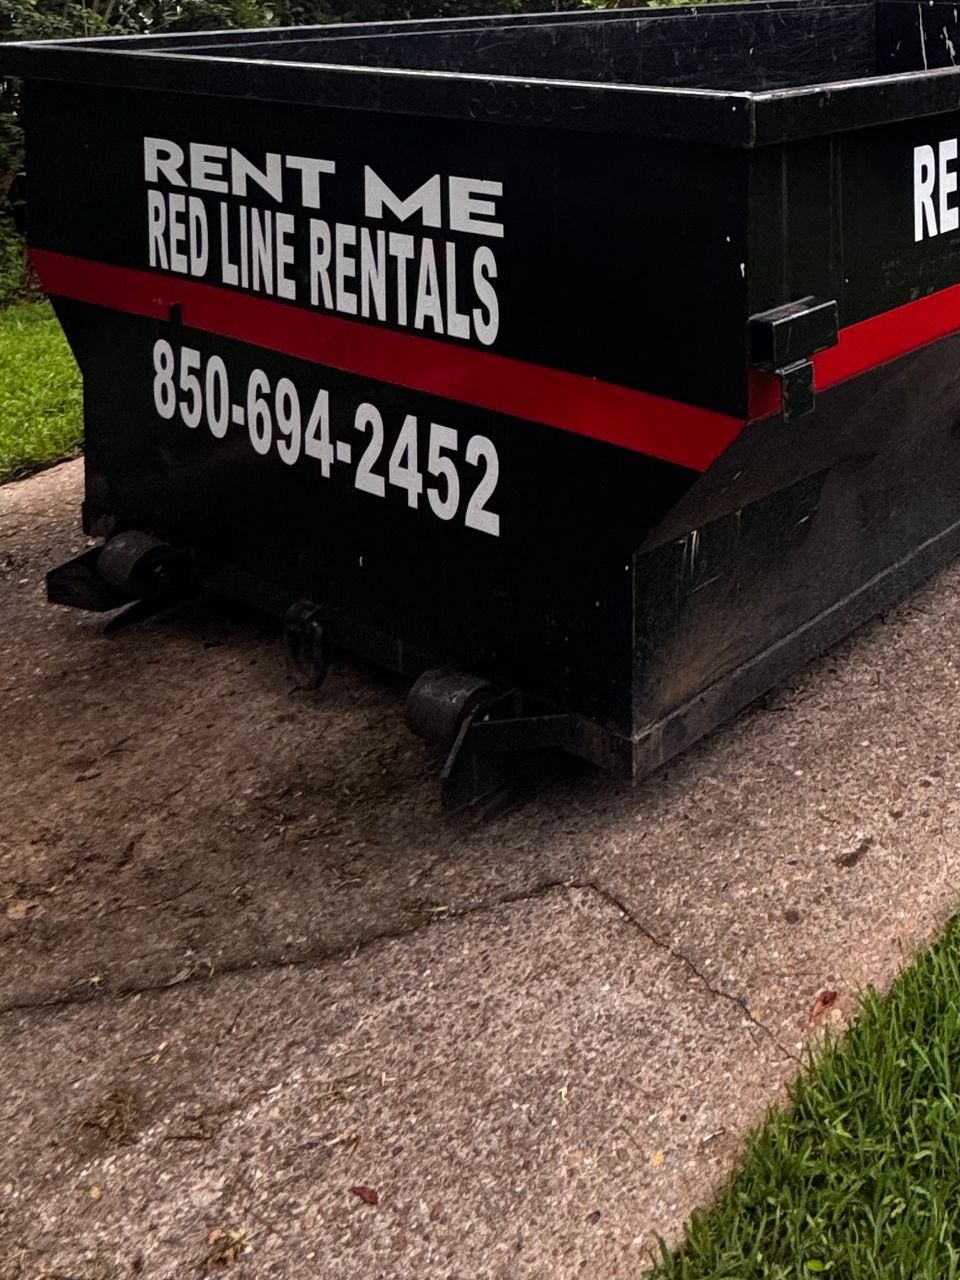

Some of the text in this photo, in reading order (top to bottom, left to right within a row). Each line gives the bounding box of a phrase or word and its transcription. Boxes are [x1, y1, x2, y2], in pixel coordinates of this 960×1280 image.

[143, 136, 505, 238] RENT ME
[147, 189, 500, 346] RED LINE RENTALS
[152, 338, 500, 537] 850-694-2452
